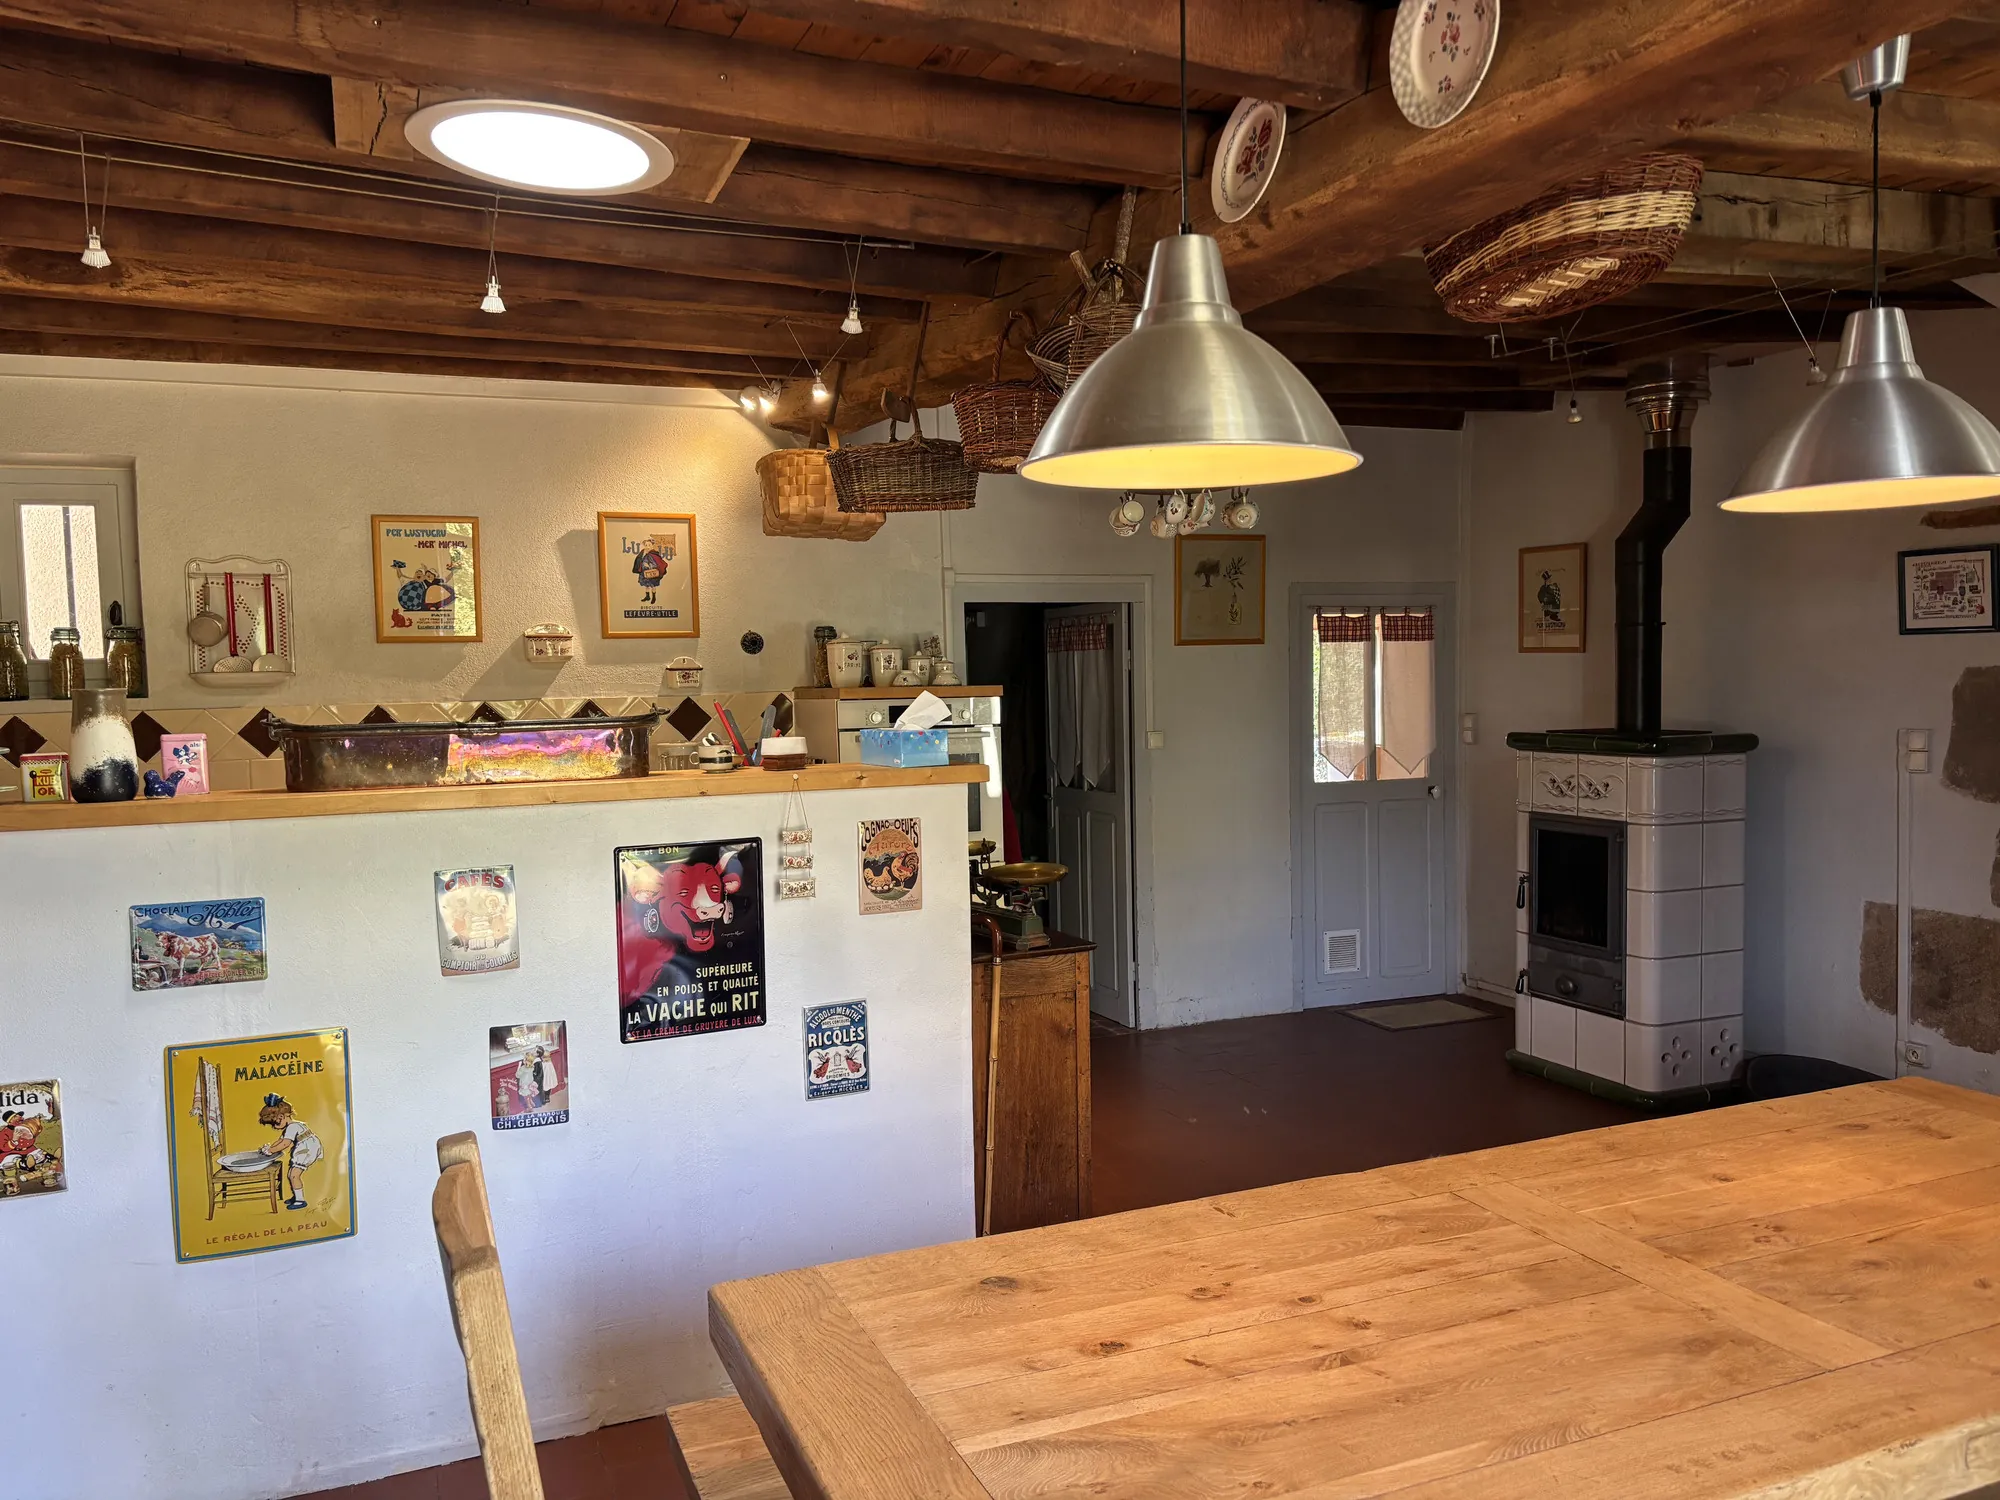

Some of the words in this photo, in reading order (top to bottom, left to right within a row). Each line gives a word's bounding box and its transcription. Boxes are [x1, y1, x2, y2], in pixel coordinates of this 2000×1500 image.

[36, 776, 56, 785] KUB
[38, 787, 56, 796] OR
[861, 819, 890, 851] COGNAC
[894, 818, 919, 848] OEUFS
[658, 846, 679, 855] BON
[696, 962, 753, 978] SUPÉRIEURE
[657, 986, 669, 997] EN
[674, 982, 703, 995] POIDS
[708, 981, 718, 992] ET
[722, 973, 759, 991] QUALITÉ
[627, 1012, 641, 1025] LA
[646, 998, 706, 1022] VACHE
[710, 1001, 728, 1016] QUI
[732, 991, 759, 1012] RIT
[809, 1008, 832, 1029] ALCOOL
[837, 1006, 862, 1022] MENTHE
[643, 1029, 652, 1038] LA
[682, 1024, 693, 1033] DE
[731, 1017, 741, 1027] DE
[259, 1051, 298, 1063] SAVON
[206, 1237, 219, 1245] LE
[223, 1231, 260, 1242] RÉGAL
[263, 1228, 277, 1237] DE
[280, 1226, 294, 1234] LA
[297, 1221, 328, 1231] PEAU
